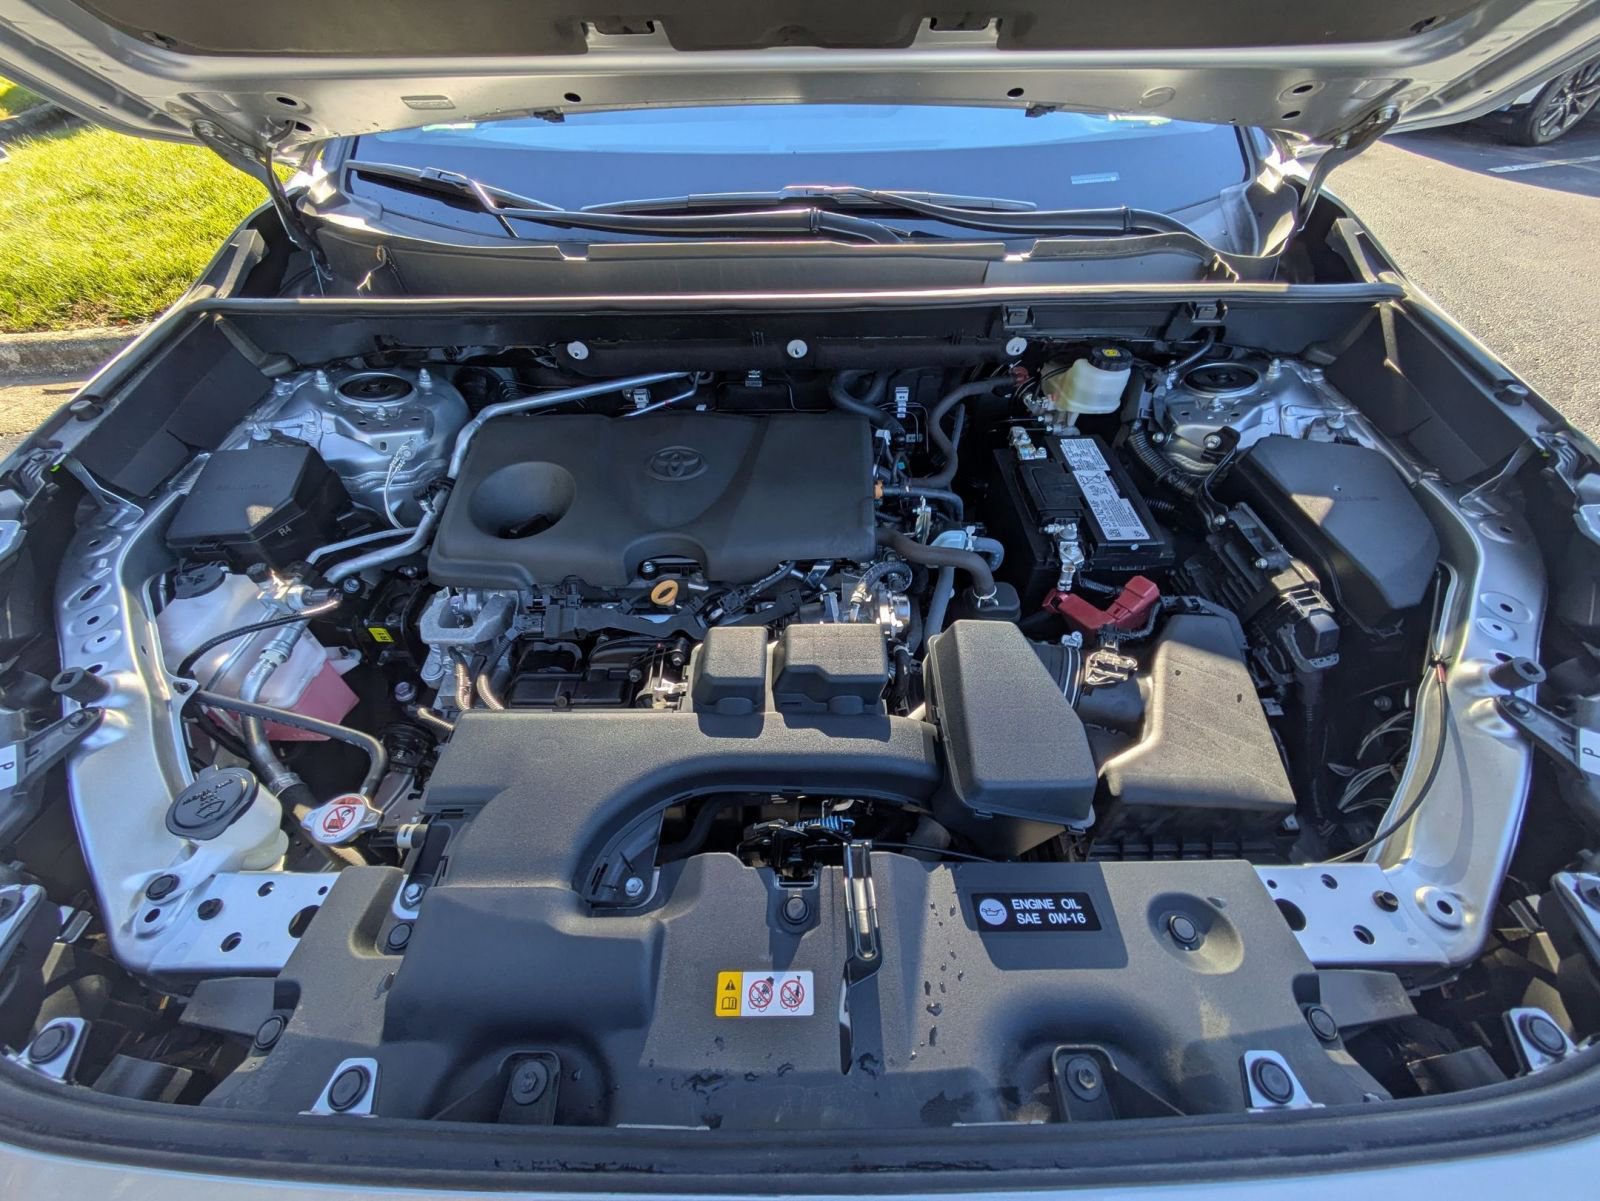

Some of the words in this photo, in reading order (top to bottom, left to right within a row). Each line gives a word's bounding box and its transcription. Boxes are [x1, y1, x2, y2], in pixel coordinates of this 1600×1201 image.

[1011, 898, 1056, 910] ENGINE
[1060, 898, 1082, 910] OIL
[1016, 912, 1042, 924] SAE
[1048, 912, 1086, 924] 0W-16
